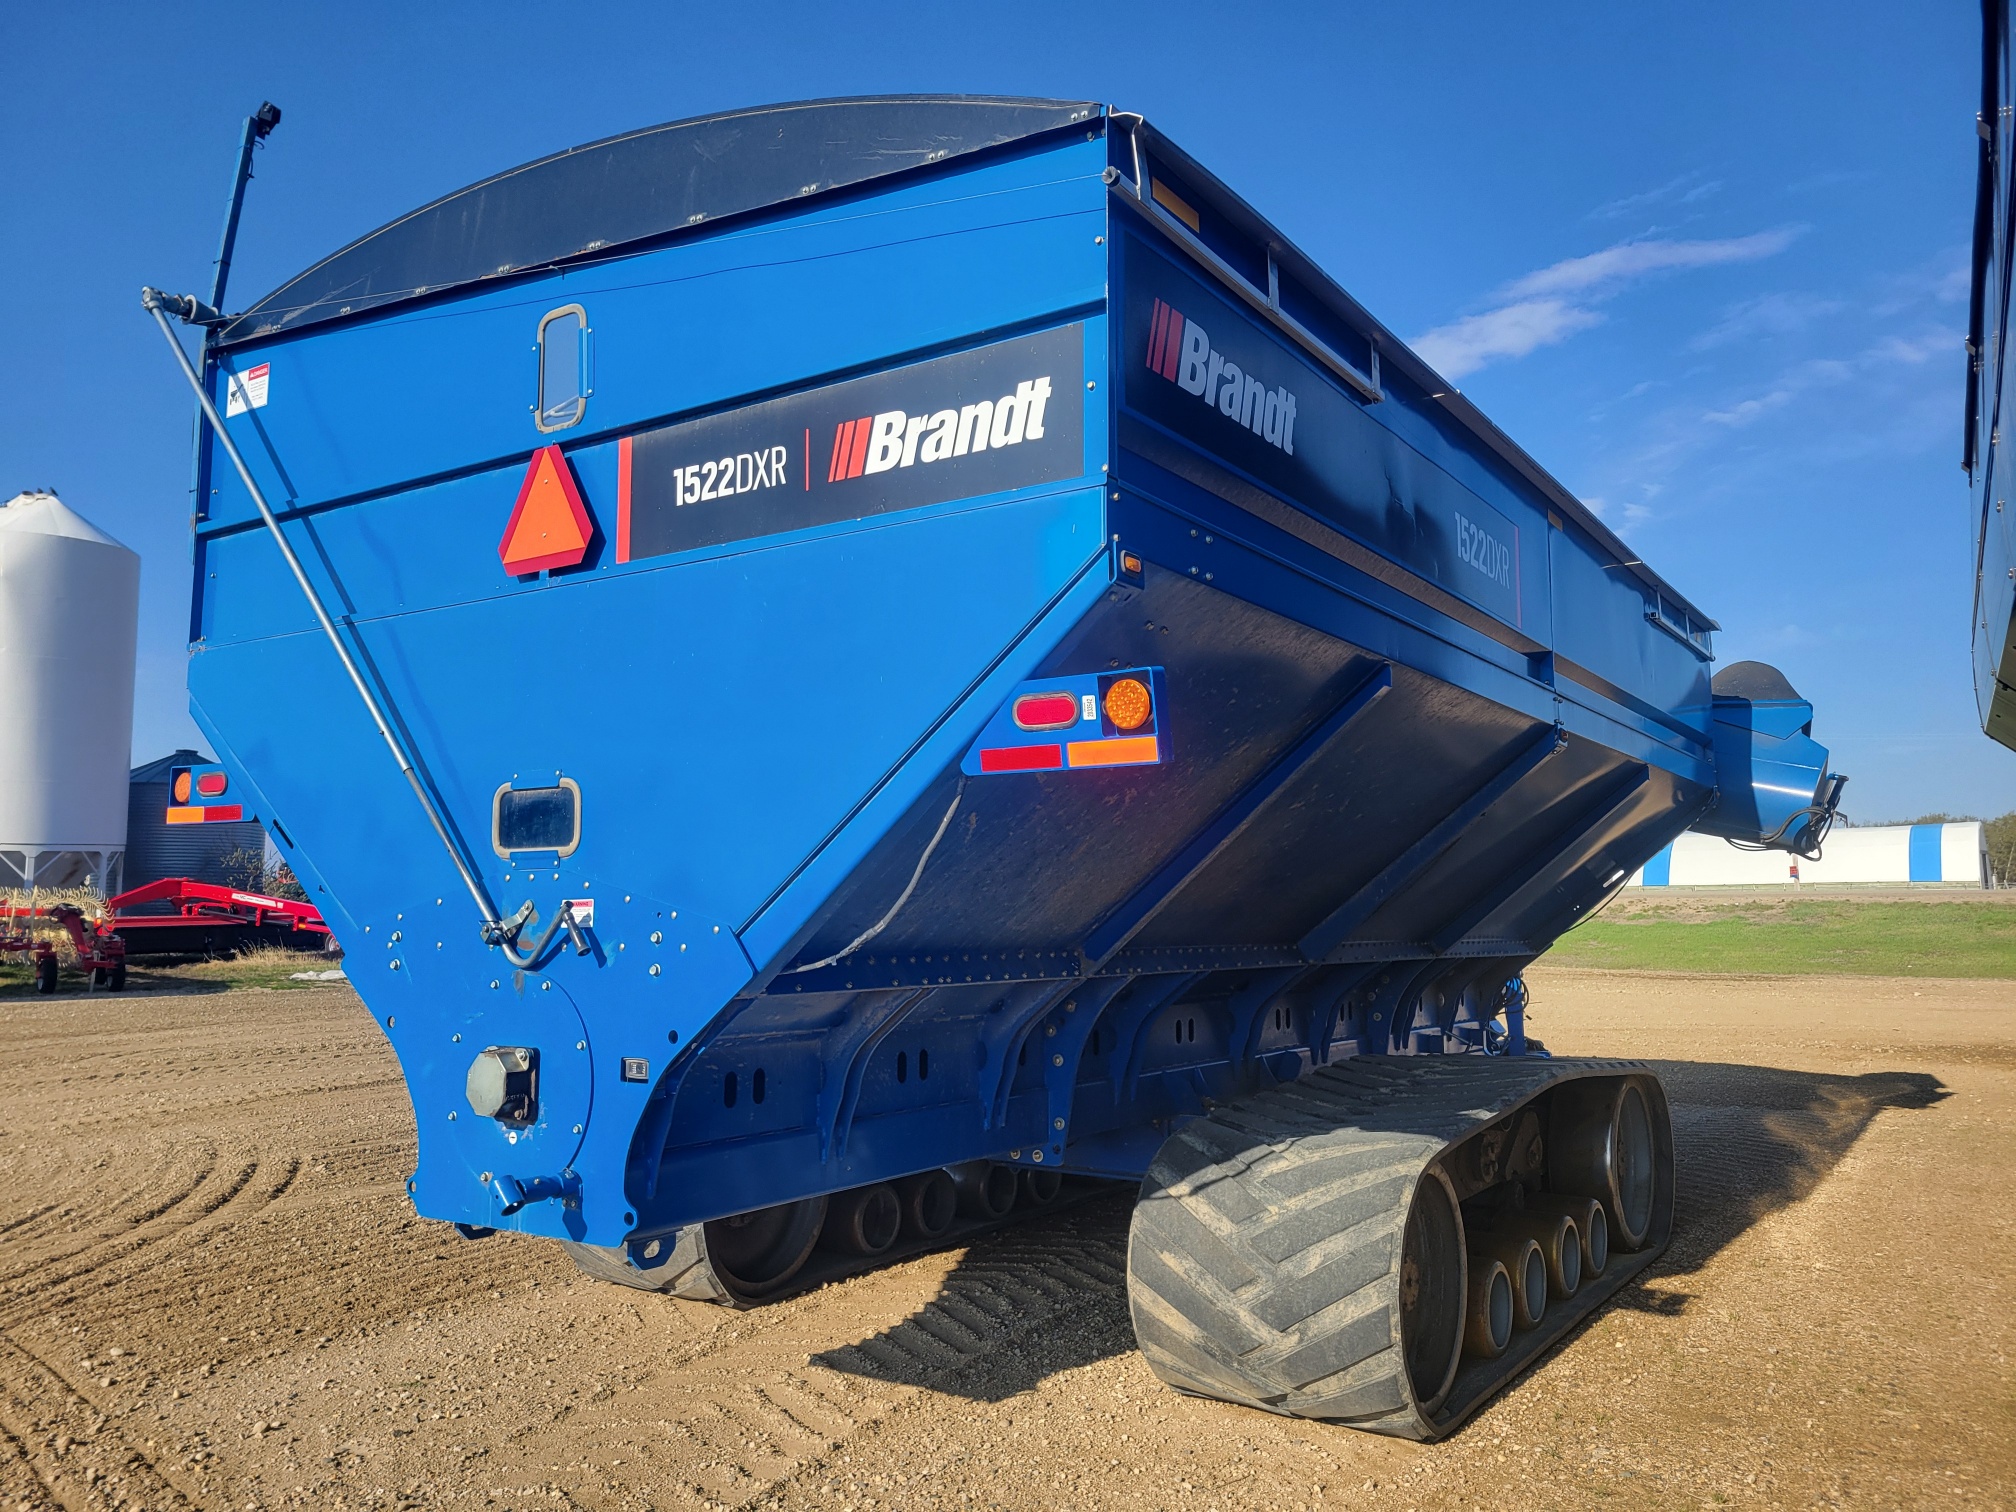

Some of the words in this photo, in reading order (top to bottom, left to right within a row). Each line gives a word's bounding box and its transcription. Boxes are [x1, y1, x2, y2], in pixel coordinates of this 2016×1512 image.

[673, 446, 787, 507] 1522DXR
[865, 376, 1053, 475] Brandt
[1178, 318, 1298, 456] Brandt
[1454, 511, 1510, 590] 1522DXR
